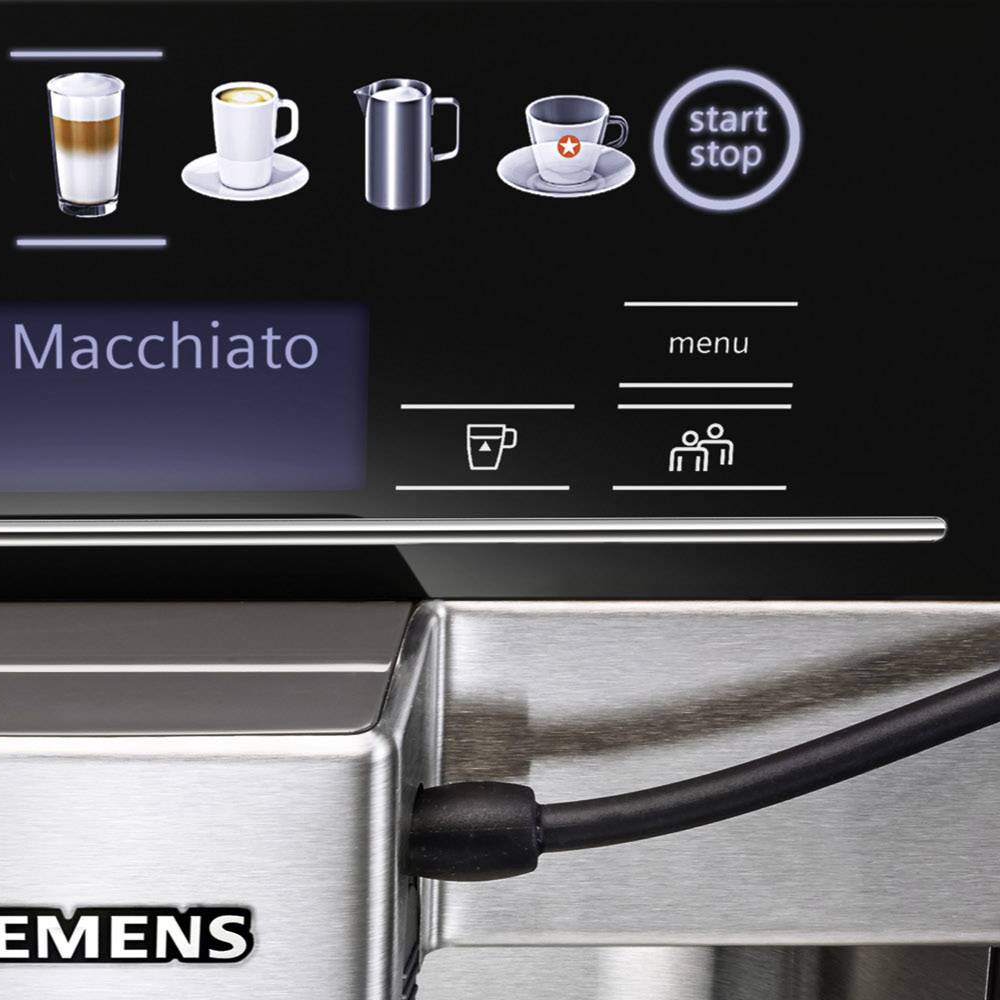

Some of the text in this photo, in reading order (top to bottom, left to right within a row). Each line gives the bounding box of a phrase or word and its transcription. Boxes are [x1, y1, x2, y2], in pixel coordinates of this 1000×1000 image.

[689, 105, 769, 134] start
[689, 140, 763, 176] stop
[13, 319, 319, 371] Macchiato
[668, 335, 750, 355] menu
